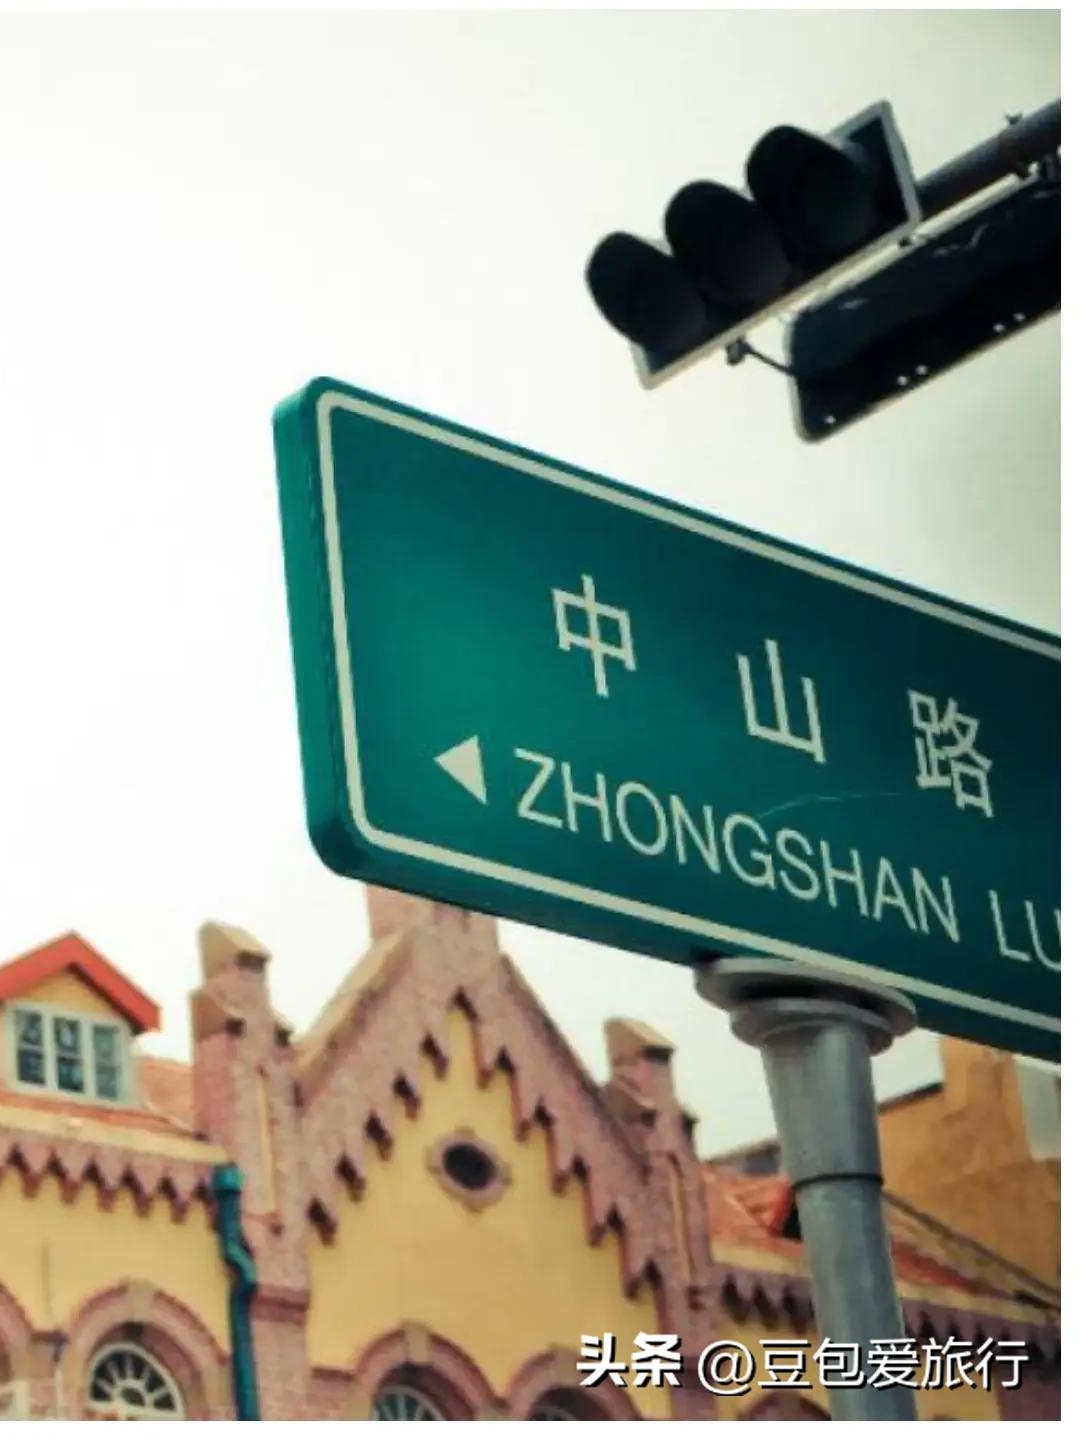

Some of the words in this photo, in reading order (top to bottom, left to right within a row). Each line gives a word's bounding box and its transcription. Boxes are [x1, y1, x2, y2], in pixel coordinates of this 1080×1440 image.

[552, 574, 994, 819] 中山路
[514, 747, 961, 943] ZHONGSHAN
[988, 889, 1062, 972] LU
